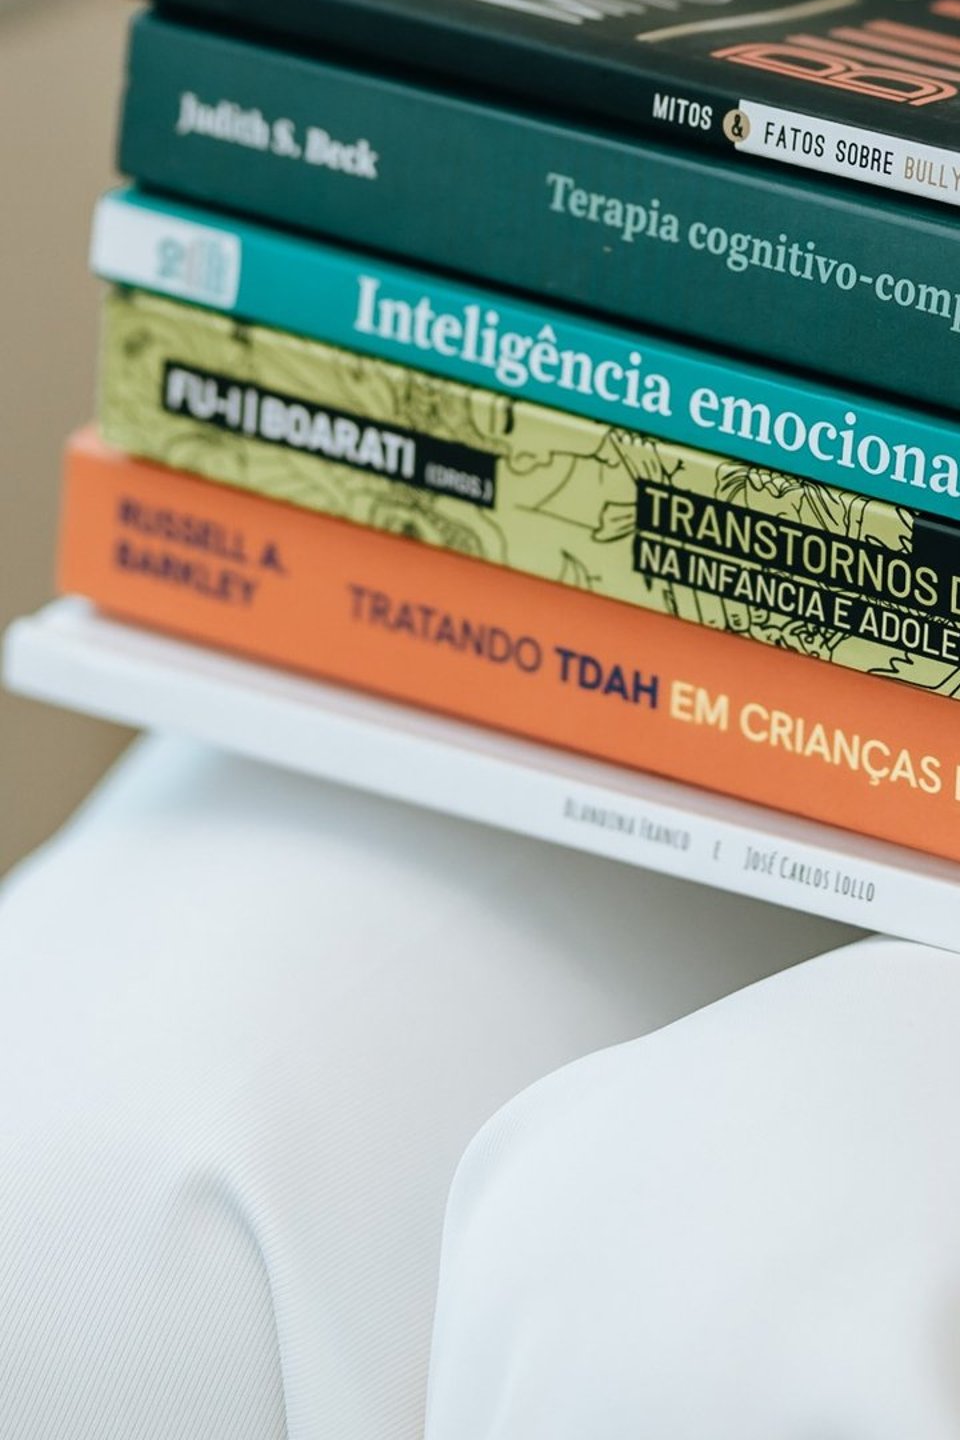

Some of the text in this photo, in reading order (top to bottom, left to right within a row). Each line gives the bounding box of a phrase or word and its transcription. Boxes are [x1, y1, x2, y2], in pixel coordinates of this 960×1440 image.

[652, 93, 713, 131] MITOS
[731, 114, 744, 138] &
[764, 121, 826, 158] FATOS
[835, 140, 895, 176] SOBRE
[546, 171, 680, 243] Terapia
[354, 275, 672, 417] Inteligência
[260, 394, 416, 479] BOARATI
[640, 541, 681, 576] NA
[833, 597, 853, 629] E
[645, 486, 938, 607] TRANSTORNOS
[348, 582, 543, 674] TRATANDO
[554, 645, 660, 710] TDAH
[670, 681, 728, 732] EM
[740, 702, 943, 795] CRIANÇAS
